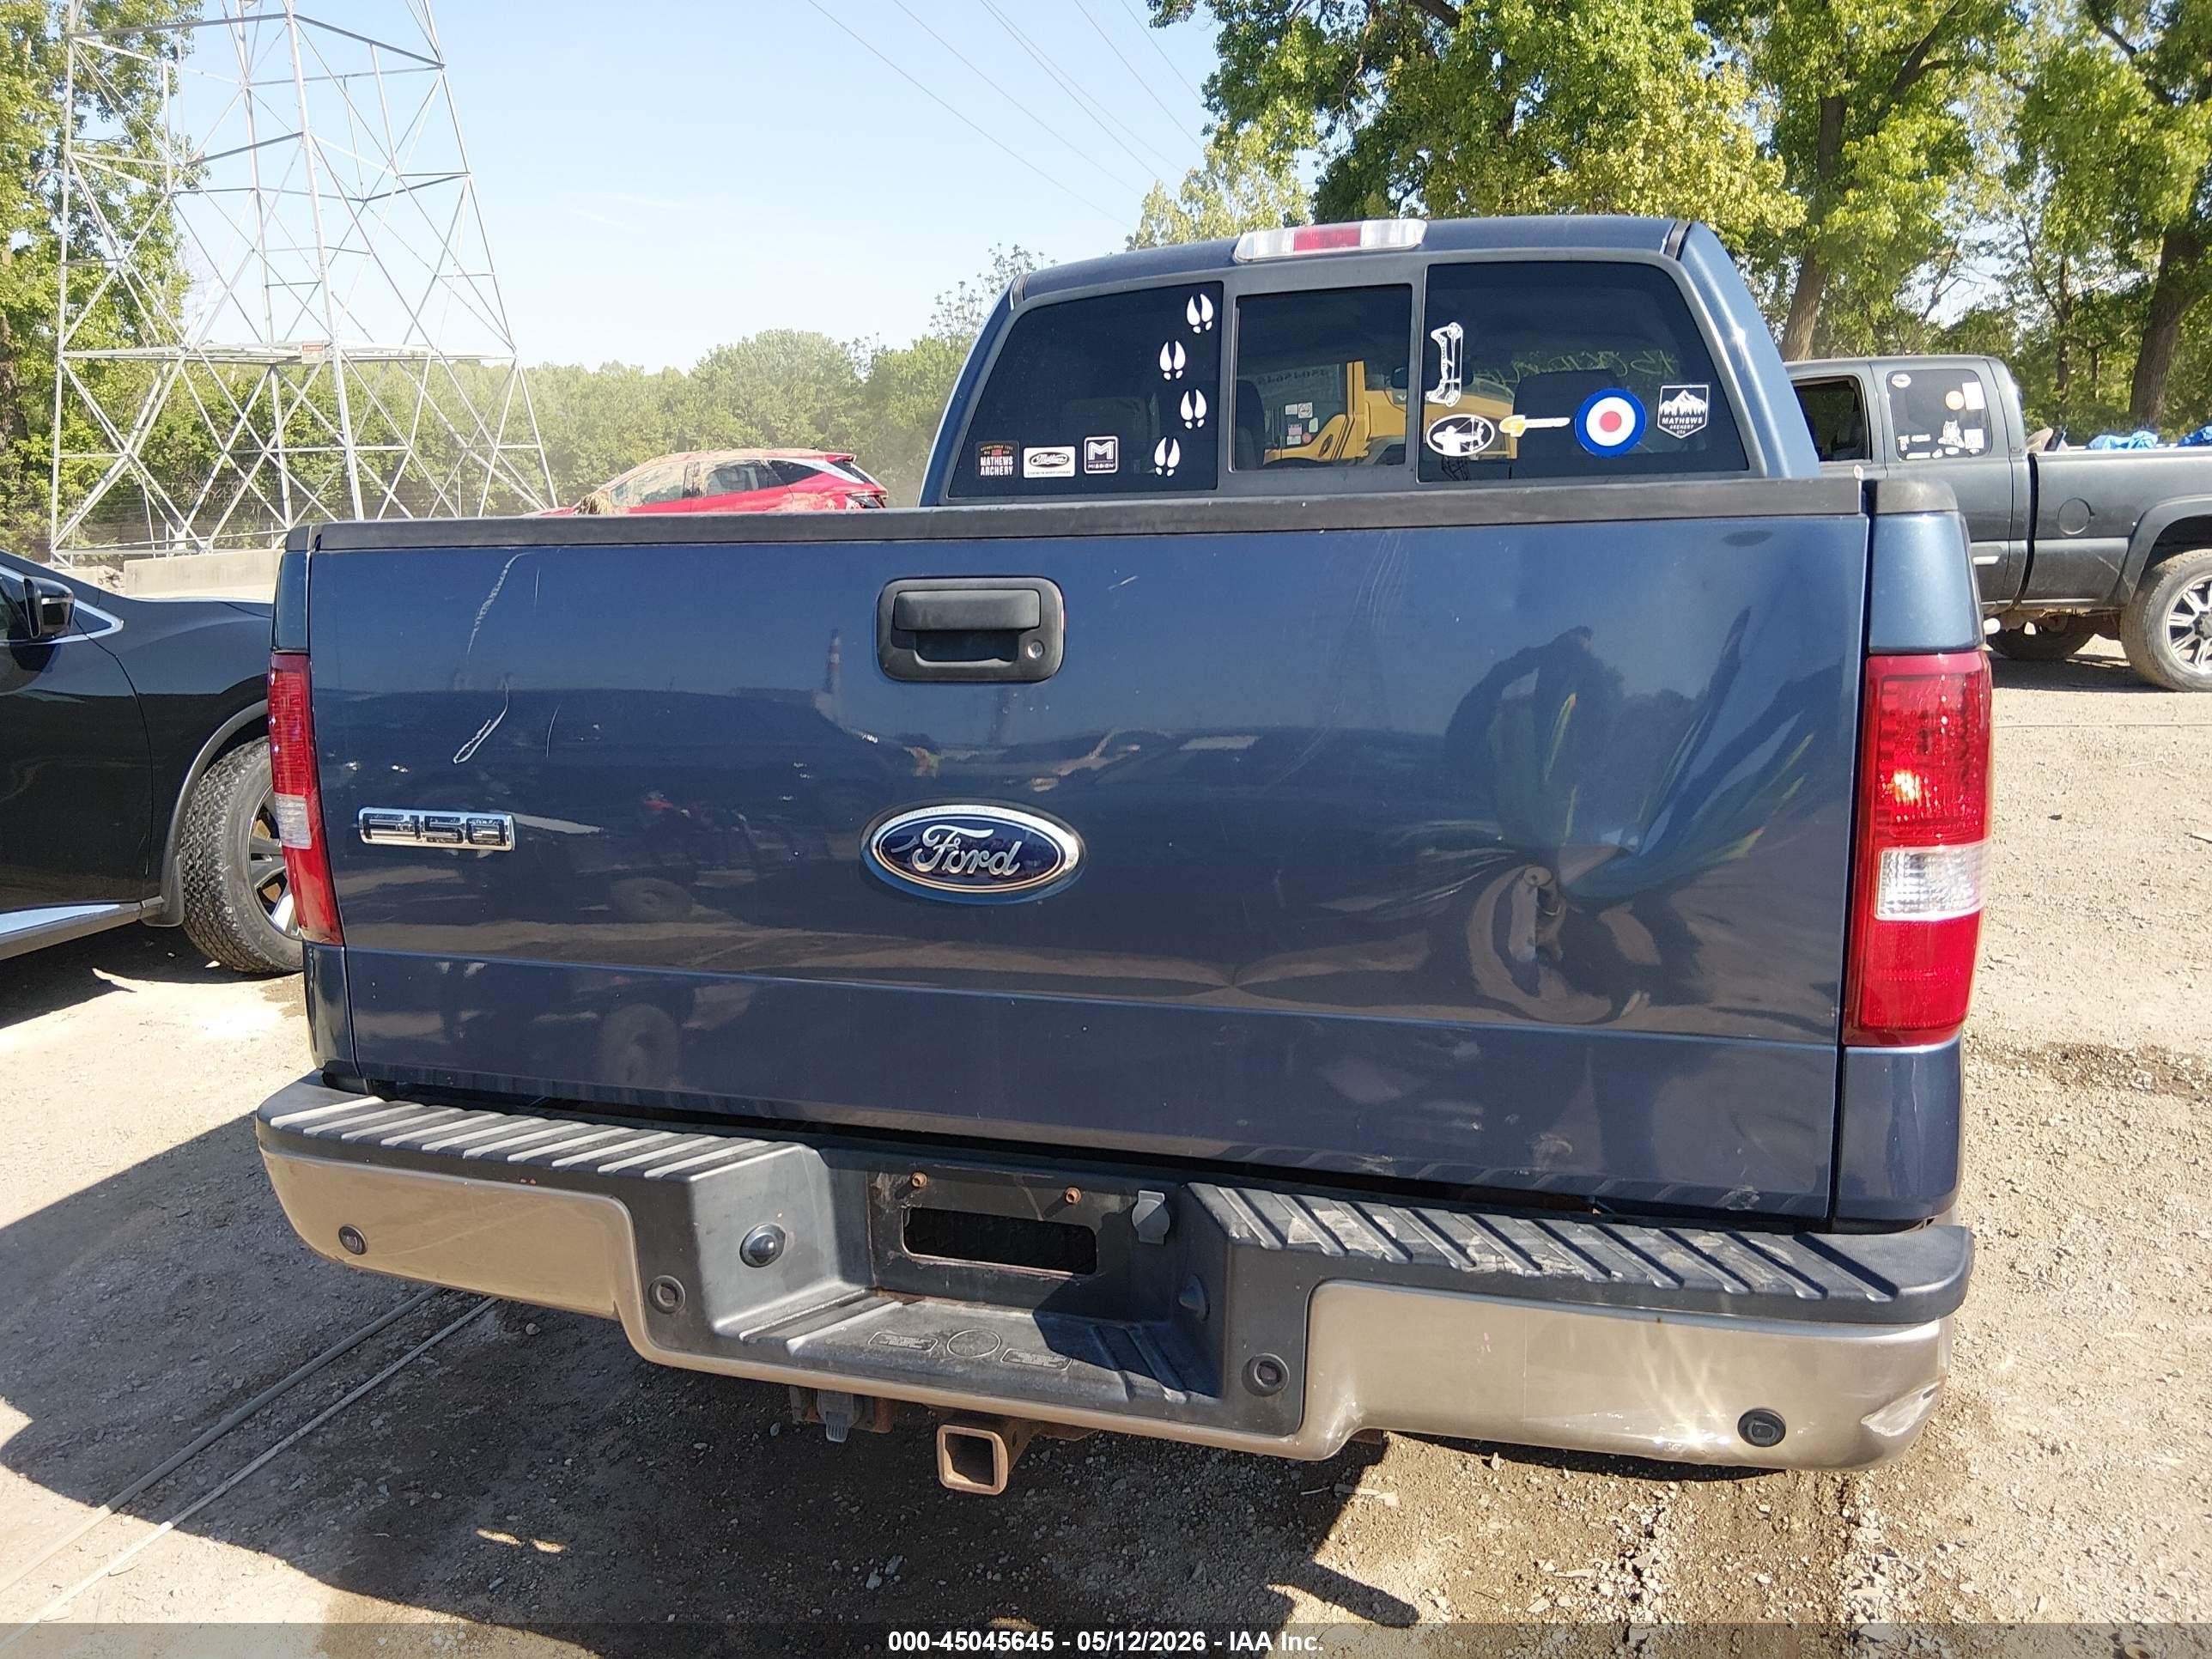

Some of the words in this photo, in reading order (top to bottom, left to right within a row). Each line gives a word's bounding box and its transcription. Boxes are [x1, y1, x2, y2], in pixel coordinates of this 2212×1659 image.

[980, 455, 1013, 466] MATHEWS
[980, 466, 1013, 477] ARCHERY
[912, 824, 1023, 876] Ford
